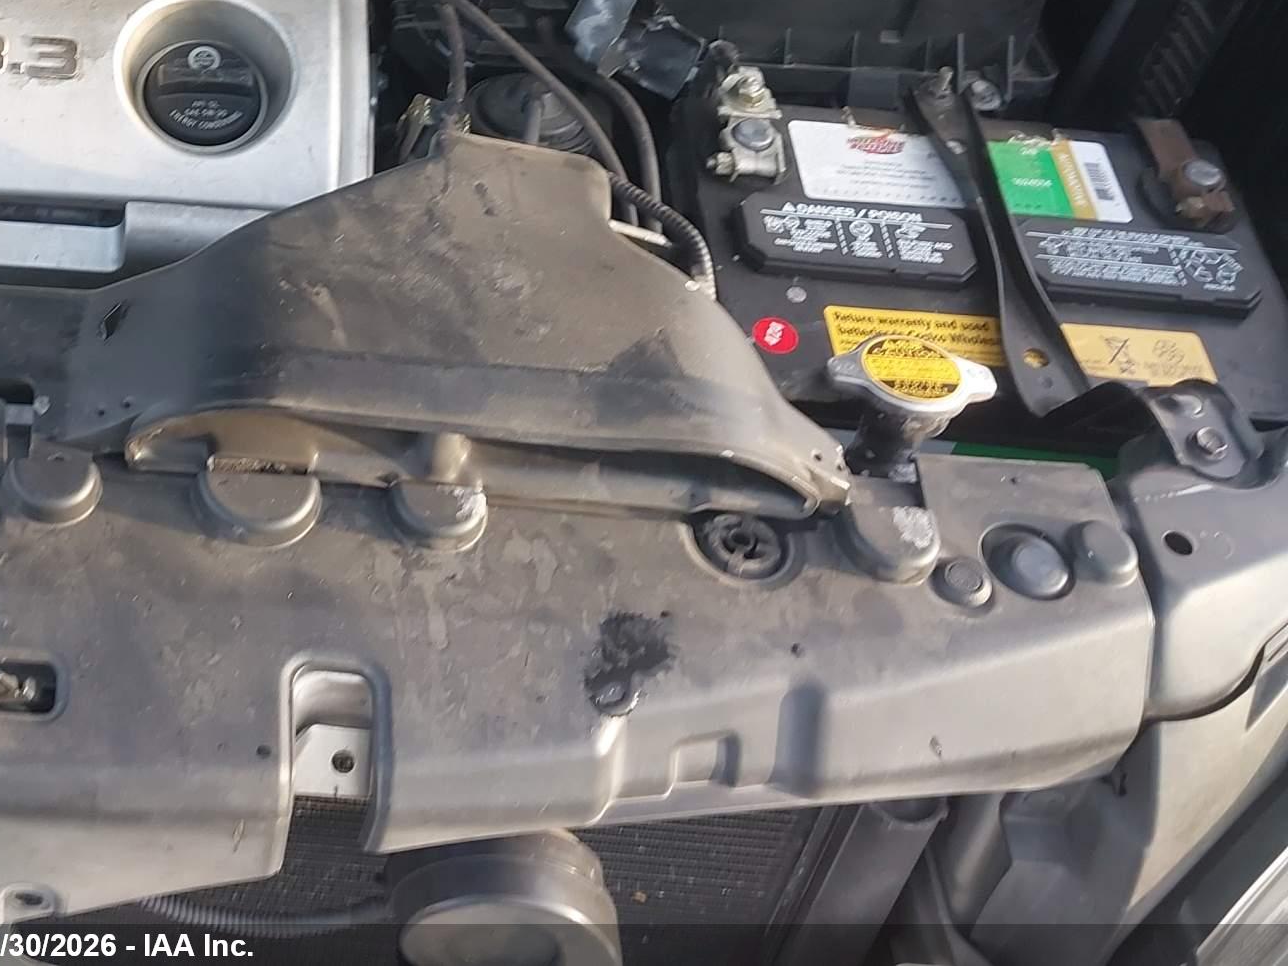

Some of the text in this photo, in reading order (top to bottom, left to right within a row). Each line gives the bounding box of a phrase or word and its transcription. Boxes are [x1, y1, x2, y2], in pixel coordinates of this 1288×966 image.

[797, 203, 857, 217] DANGER
[867, 209, 922, 223] POISON
[879, 316, 931, 330] warranty
[935, 320, 958, 330] and
